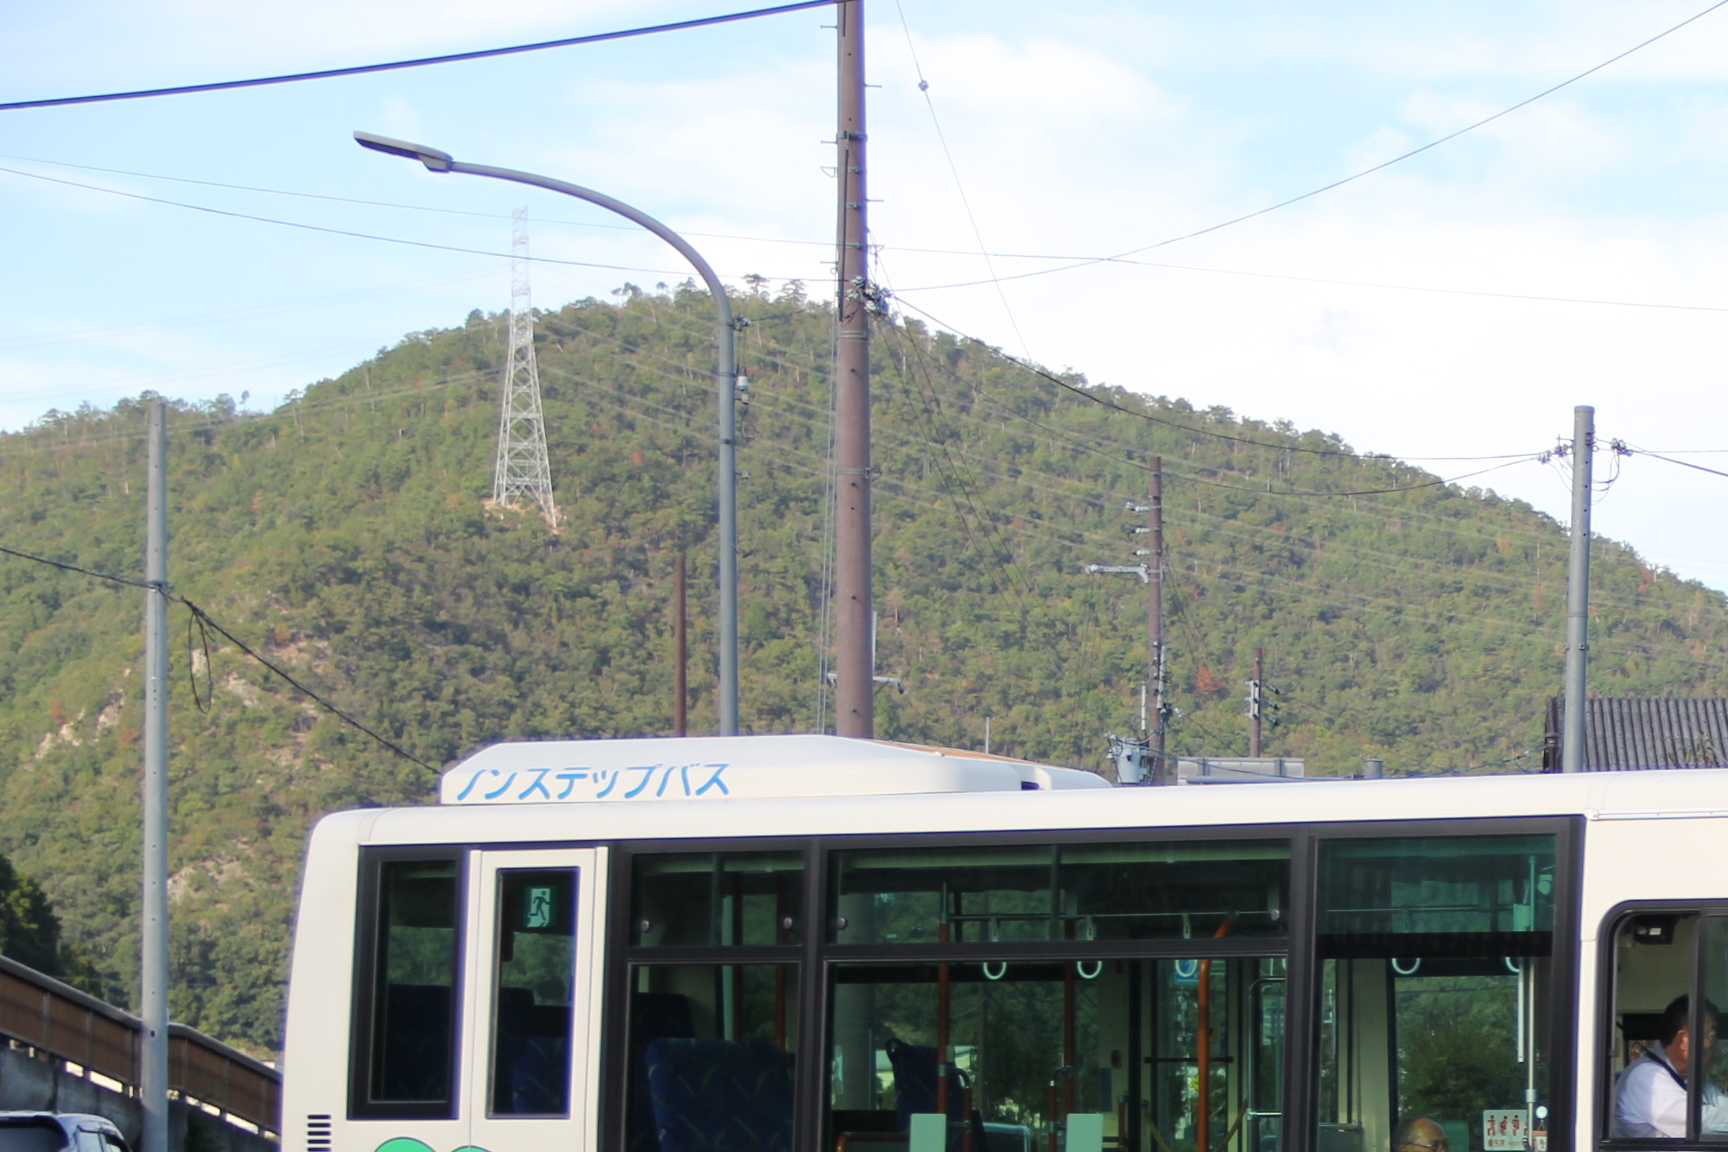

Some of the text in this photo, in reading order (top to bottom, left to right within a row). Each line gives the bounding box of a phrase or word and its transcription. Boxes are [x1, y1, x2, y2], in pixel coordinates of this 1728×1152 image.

[457, 763, 730, 801] ノンステップバス
